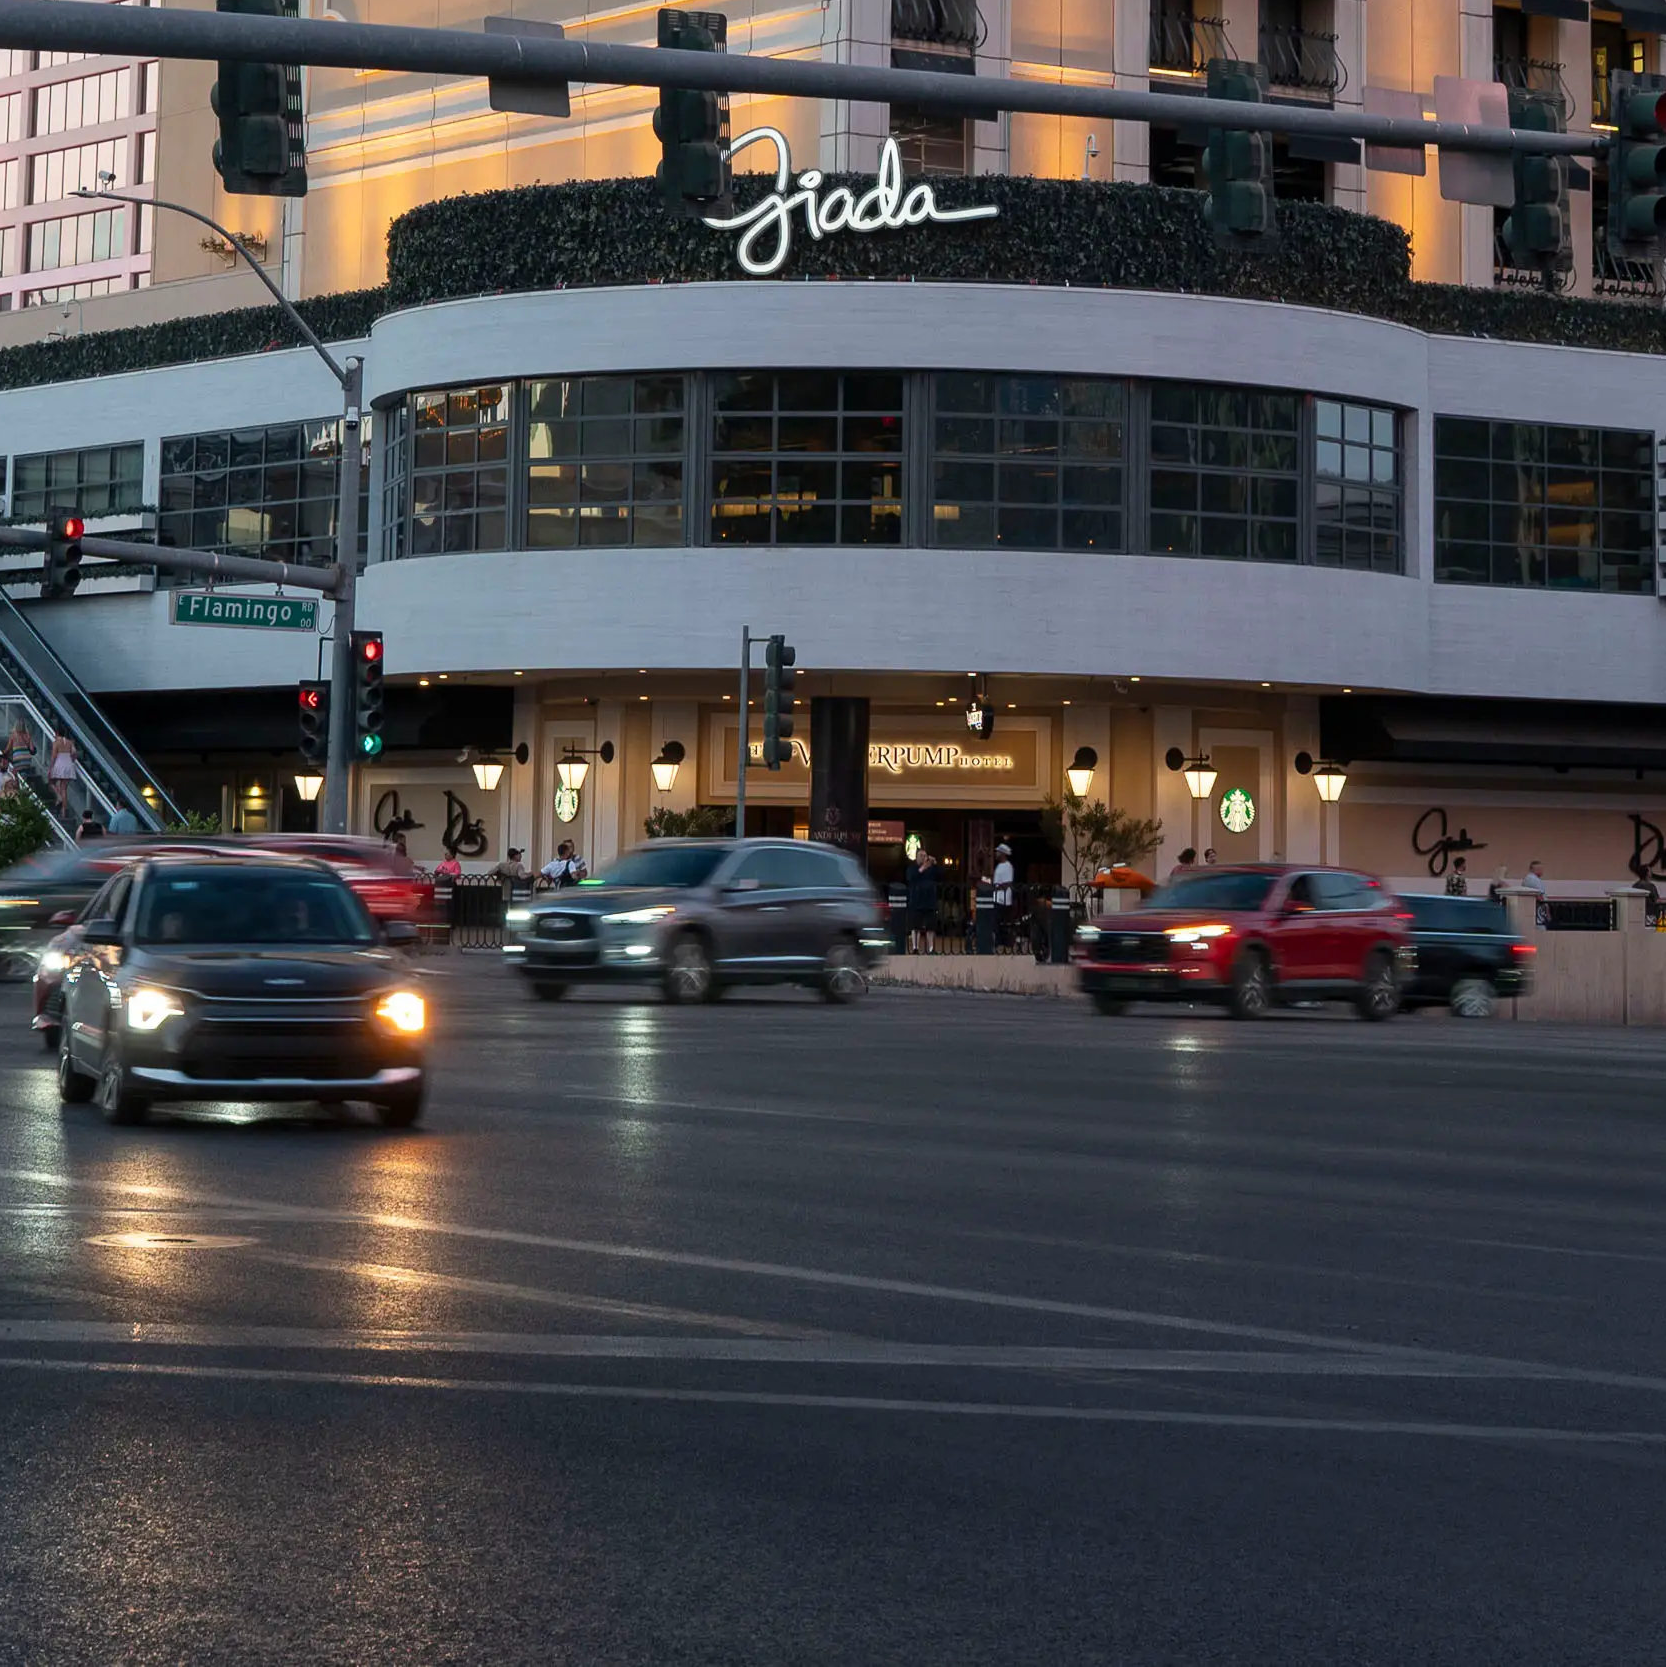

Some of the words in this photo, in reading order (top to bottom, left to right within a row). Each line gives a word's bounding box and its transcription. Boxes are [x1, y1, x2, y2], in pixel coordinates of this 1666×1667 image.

[178, 595, 185, 605] E
[189, 596, 292, 625] Flamingo
[301, 602, 313, 612] RD
[959, 756, 1014, 768] HOTEL
